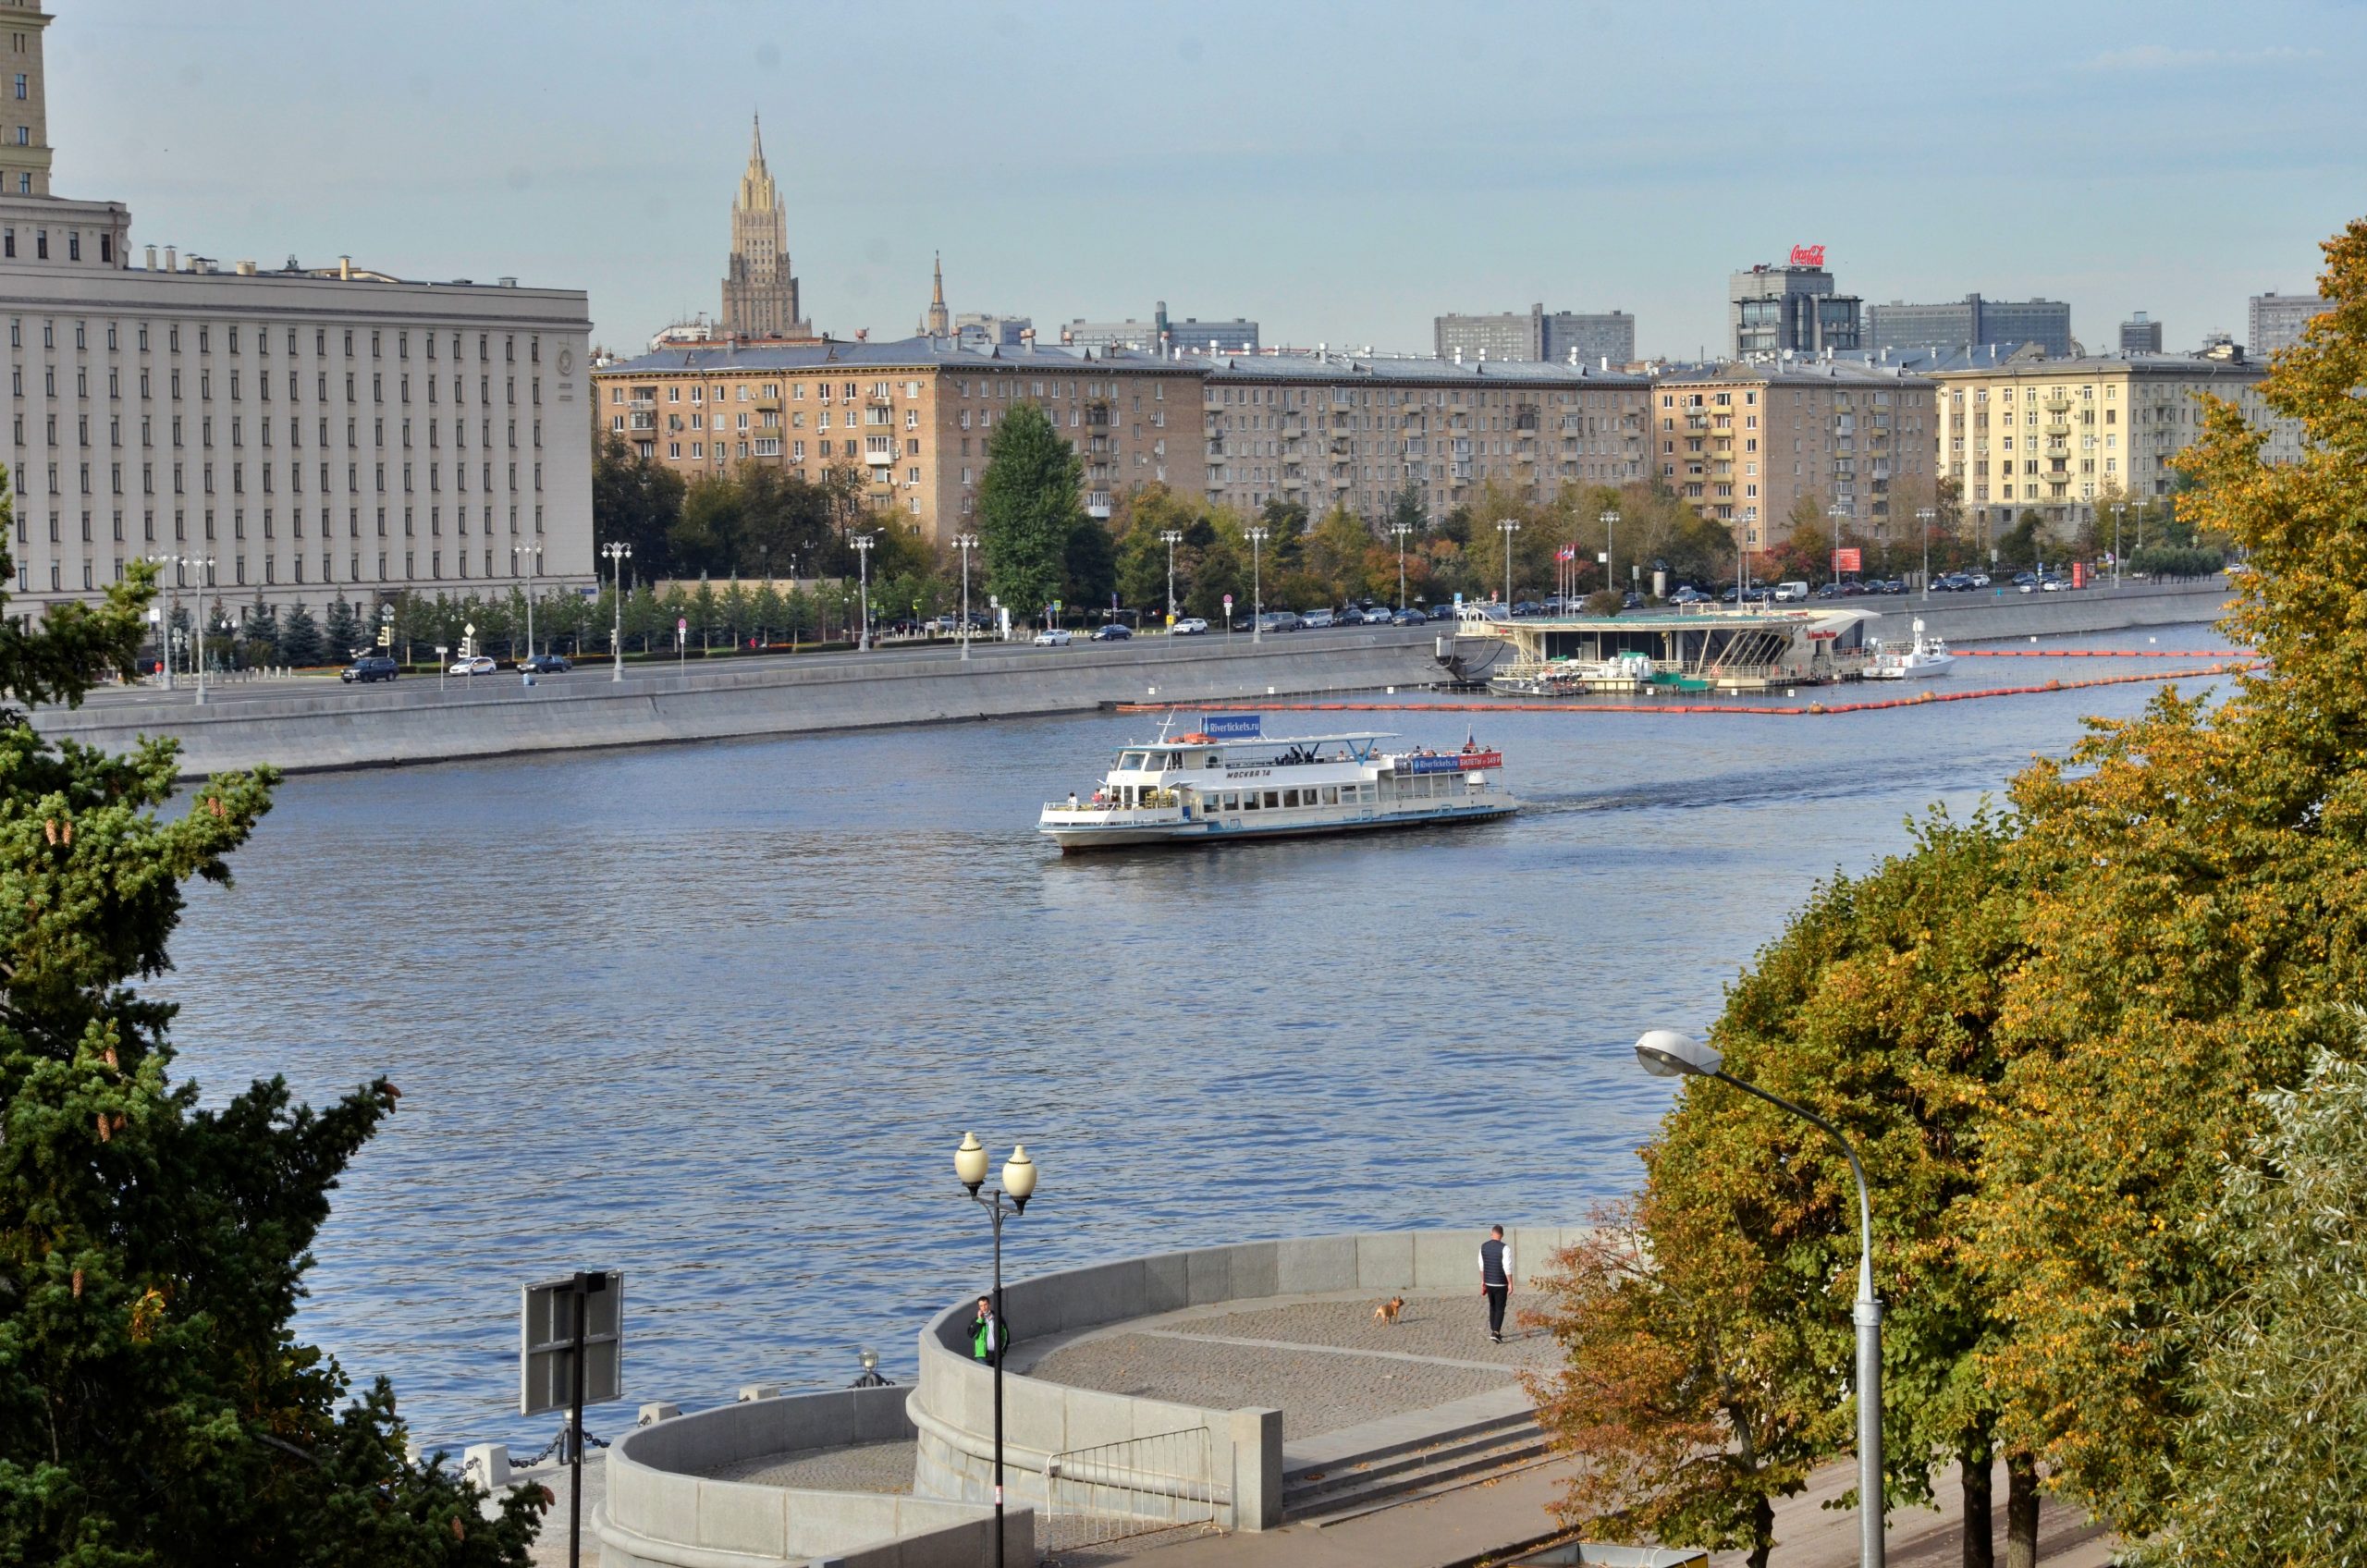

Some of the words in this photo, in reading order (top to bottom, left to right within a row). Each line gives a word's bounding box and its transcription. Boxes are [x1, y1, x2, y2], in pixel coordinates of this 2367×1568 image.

[1791, 244, 1825, 265] Coca-Cola
[1210, 722, 1259, 732] Rivertickets.ru
[1420, 758, 1458, 768] Rivertickets.ru
[1227, 770, 1259, 778] МОСКВА
